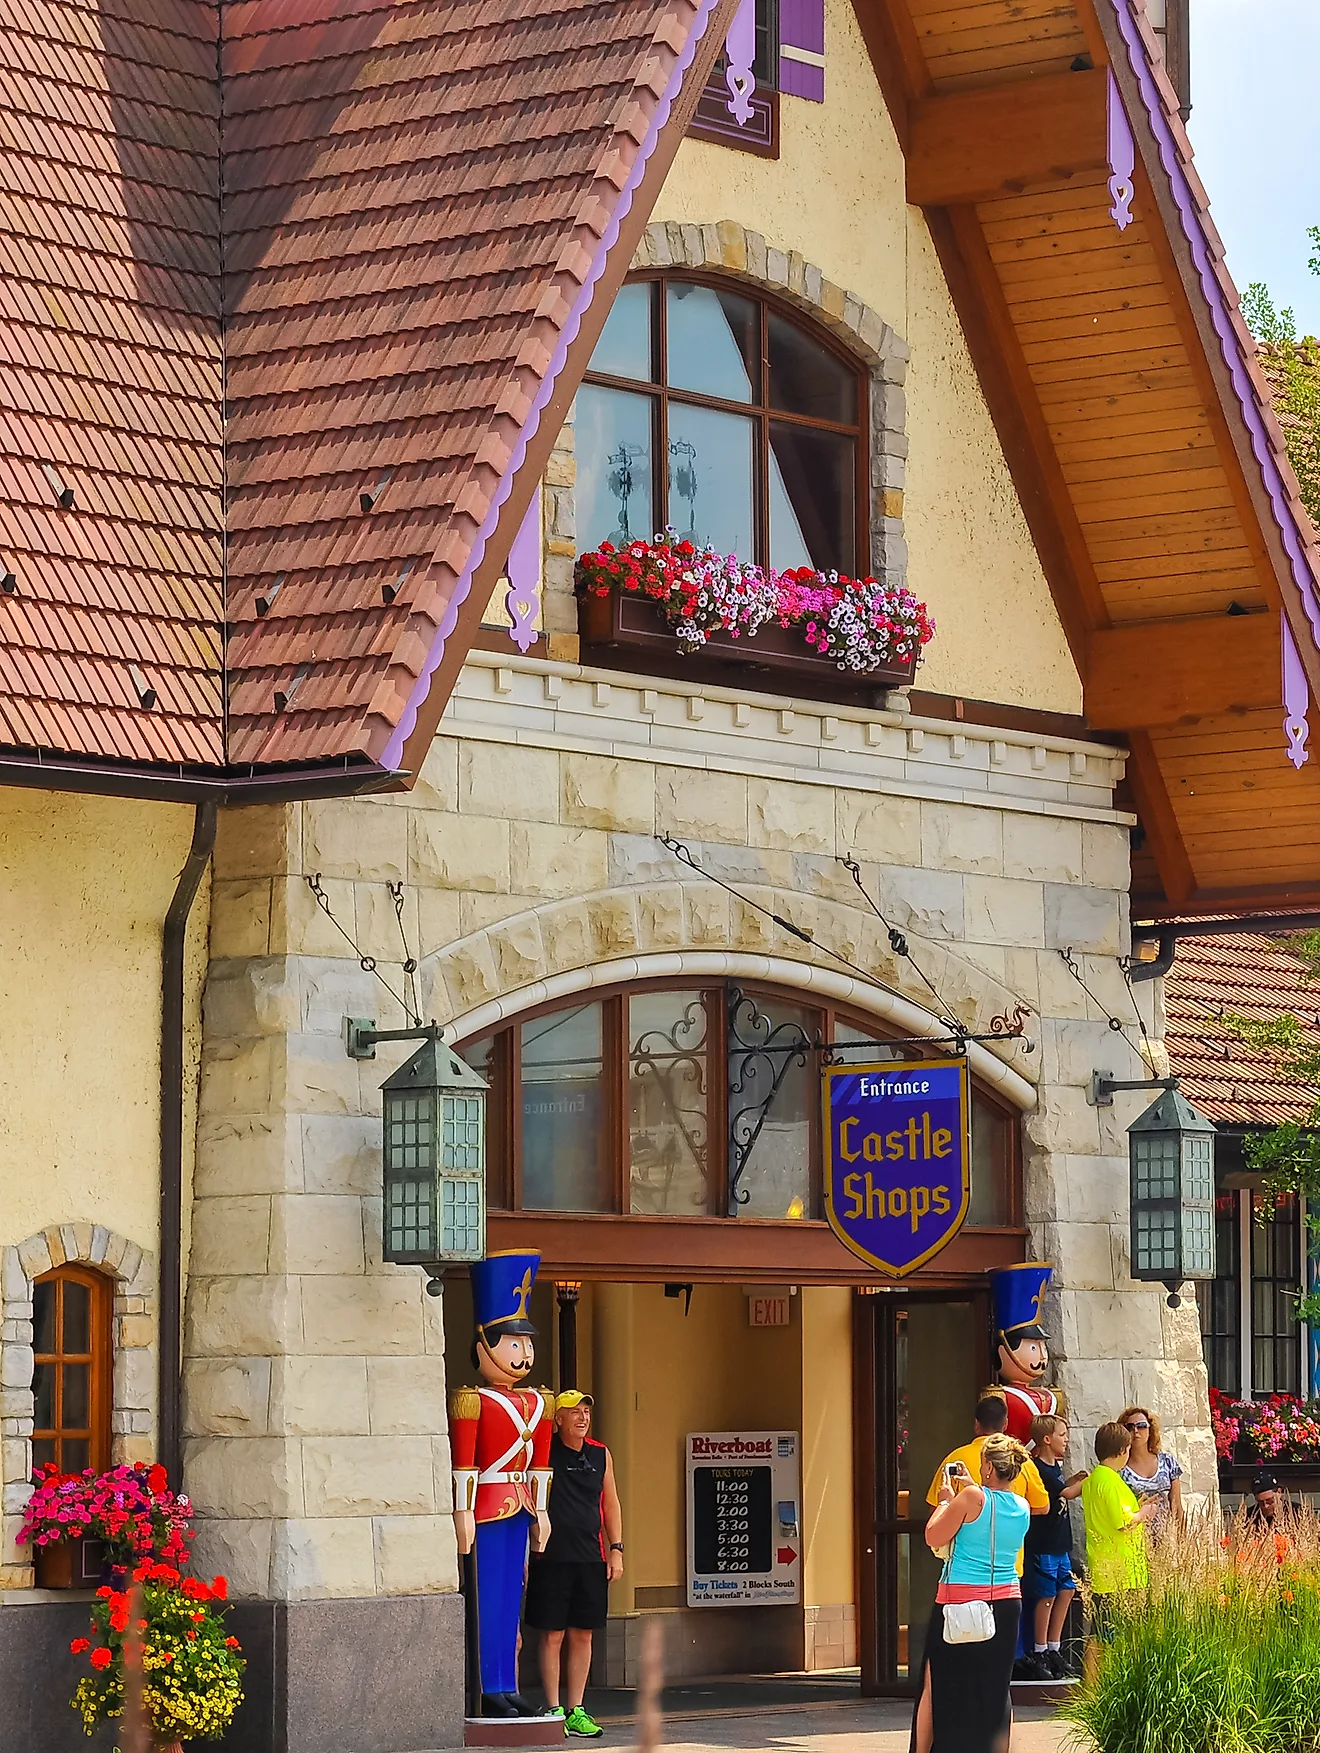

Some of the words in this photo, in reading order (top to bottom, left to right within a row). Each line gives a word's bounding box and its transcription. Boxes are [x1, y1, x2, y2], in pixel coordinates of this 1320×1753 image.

[860, 1077, 930, 1097] Entrance
[839, 1111, 953, 1163] Castle
[843, 1171, 950, 1234] Shops
[754, 1299, 785, 1324] EXIT
[691, 1436, 773, 1454] Riverboat
[711, 1469, 731, 1478] TOURS
[732, 1468, 755, 1477] TODAY
[716, 1481, 748, 1492] 11:00
[716, 1494, 748, 1504] 12:30
[716, 1506, 748, 1517] 2:00
[717, 1520, 748, 1531] 3:30
[717, 1533, 749, 1544] 5:00
[717, 1547, 749, 1558] 6:30
[717, 1561, 749, 1571] 8:00
[693, 1580, 709, 1593] Buy
[709, 1579, 738, 1590] Tickets
[742, 1580, 747, 1589] 2
[749, 1580, 772, 1589] Blocks
[773, 1579, 795, 1588] South
[703, 1592, 713, 1600] the
